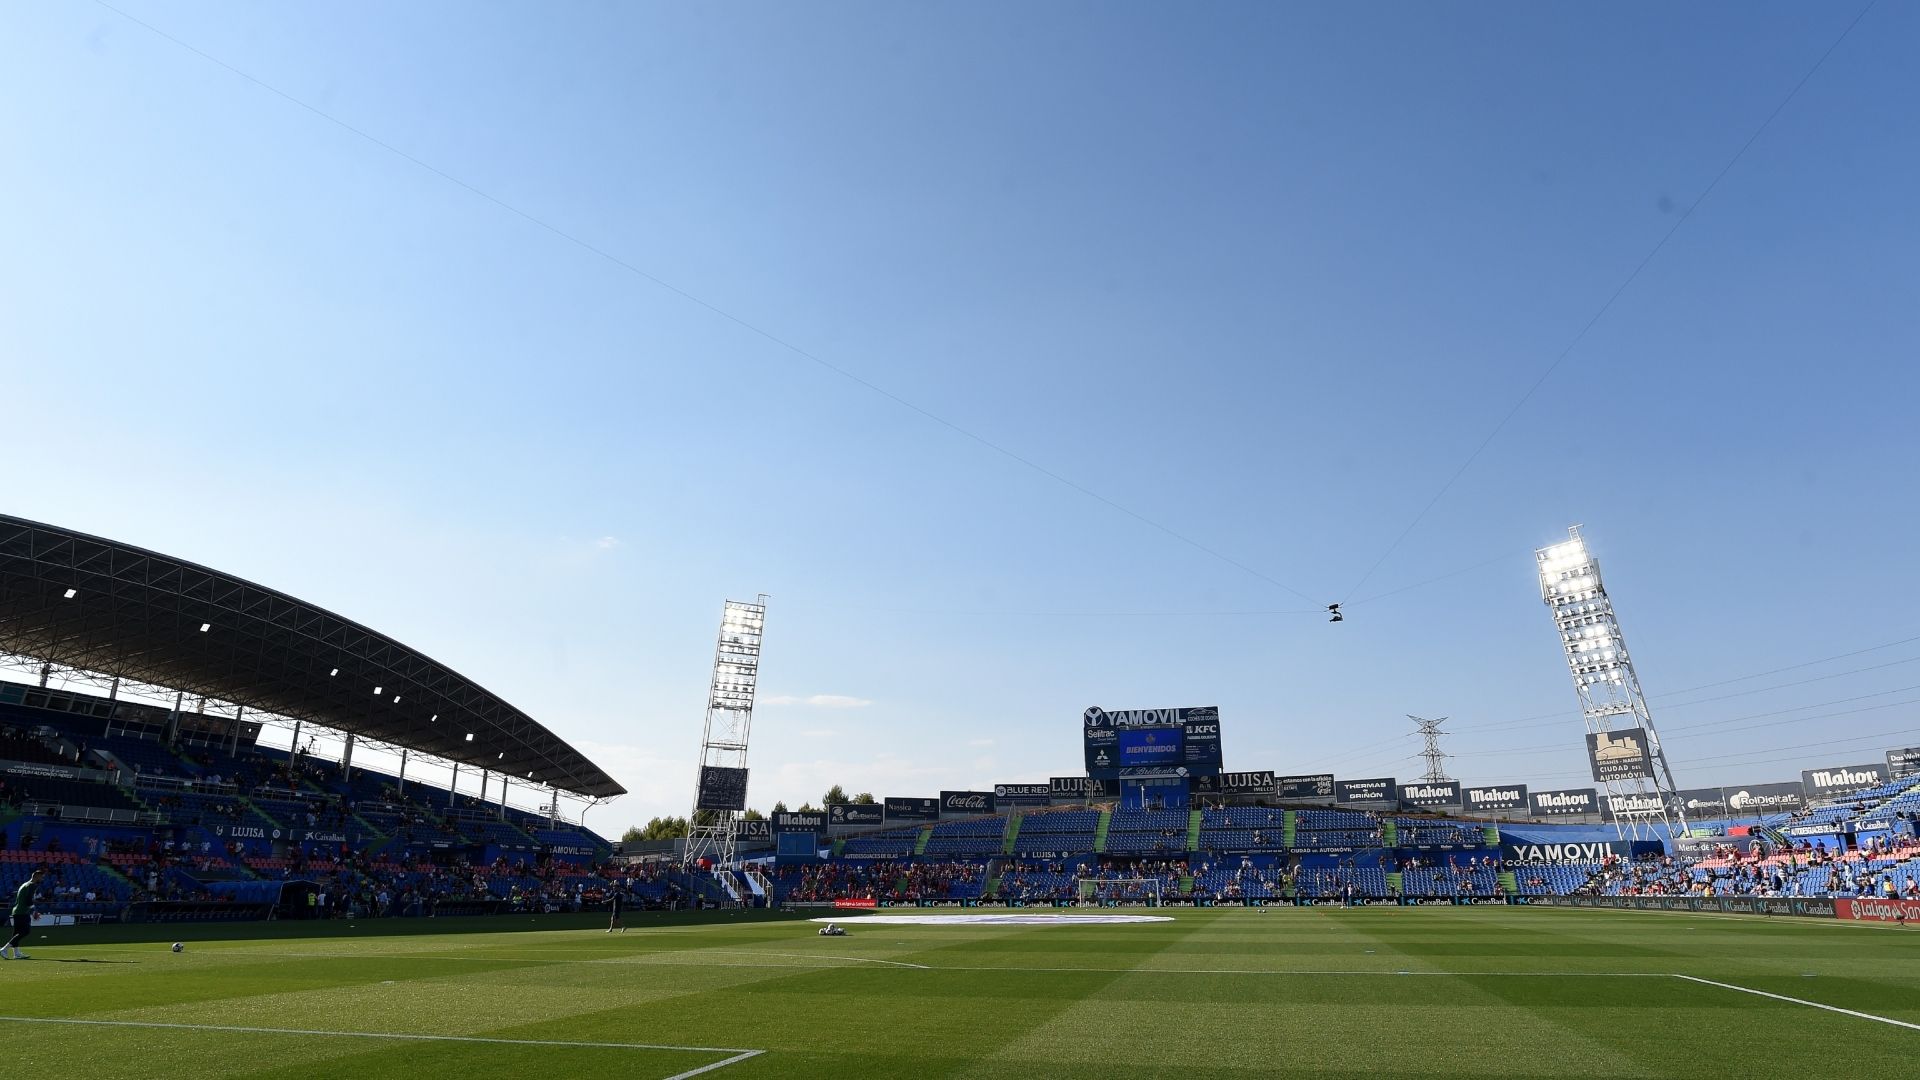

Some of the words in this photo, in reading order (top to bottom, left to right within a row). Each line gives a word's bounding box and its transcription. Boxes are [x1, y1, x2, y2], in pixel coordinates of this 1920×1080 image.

[1105, 708, 1187, 726] YAMOVIL
[1194, 725, 1217, 733] KFC
[1126, 744, 1177, 754] BIENVENIDOS
[1600, 765, 1629, 773] CIUDAD
[1219, 772, 1274, 788] LUJISA
[1600, 771, 1646, 781] AUTOMÓVIL
[1812, 769, 1878, 788] Mahou
[1006, 786, 1030, 794] BLUE
[1031, 786, 1049, 794] RED
[1051, 778, 1104, 792] LUJISA
[1349, 791, 1384, 799] GRIÑÓN
[1404, 785, 1454, 799] Mahou
[1469, 788, 1520, 803] Mahou
[946, 794, 986, 809] Coca-Cola
[1537, 792, 1590, 807] Mahou
[779, 813, 821, 826] Mahou
[1862, 820, 1890, 831] CaixaBank
[231, 827, 265, 838] LUJISA
[314, 832, 347, 842] CaixaBank
[1513, 842, 1620, 861] YAMOVIL
[1506, 859, 1553, 867] COCHES
[1555, 856, 1630, 866] SEMINUEOS
[888, 900, 917, 908] CaixaBank
[932, 900, 961, 908] CaixaBank
[976, 900, 1007, 908] CaixaBank
[1211, 899, 1245, 907] CaixaBank
[1261, 899, 1295, 907] CaixaBank
[1363, 898, 1399, 906] CaixaBank
[1416, 898, 1453, 906] CaixaBank
[1471, 897, 1508, 905] CaixaBank
[1729, 900, 1753, 912] CaixaBank
[1763, 900, 1791, 914] CaixaBank
[1803, 901, 1834, 915] CaixaBank
[1860, 900, 1892, 920] LaLiga
